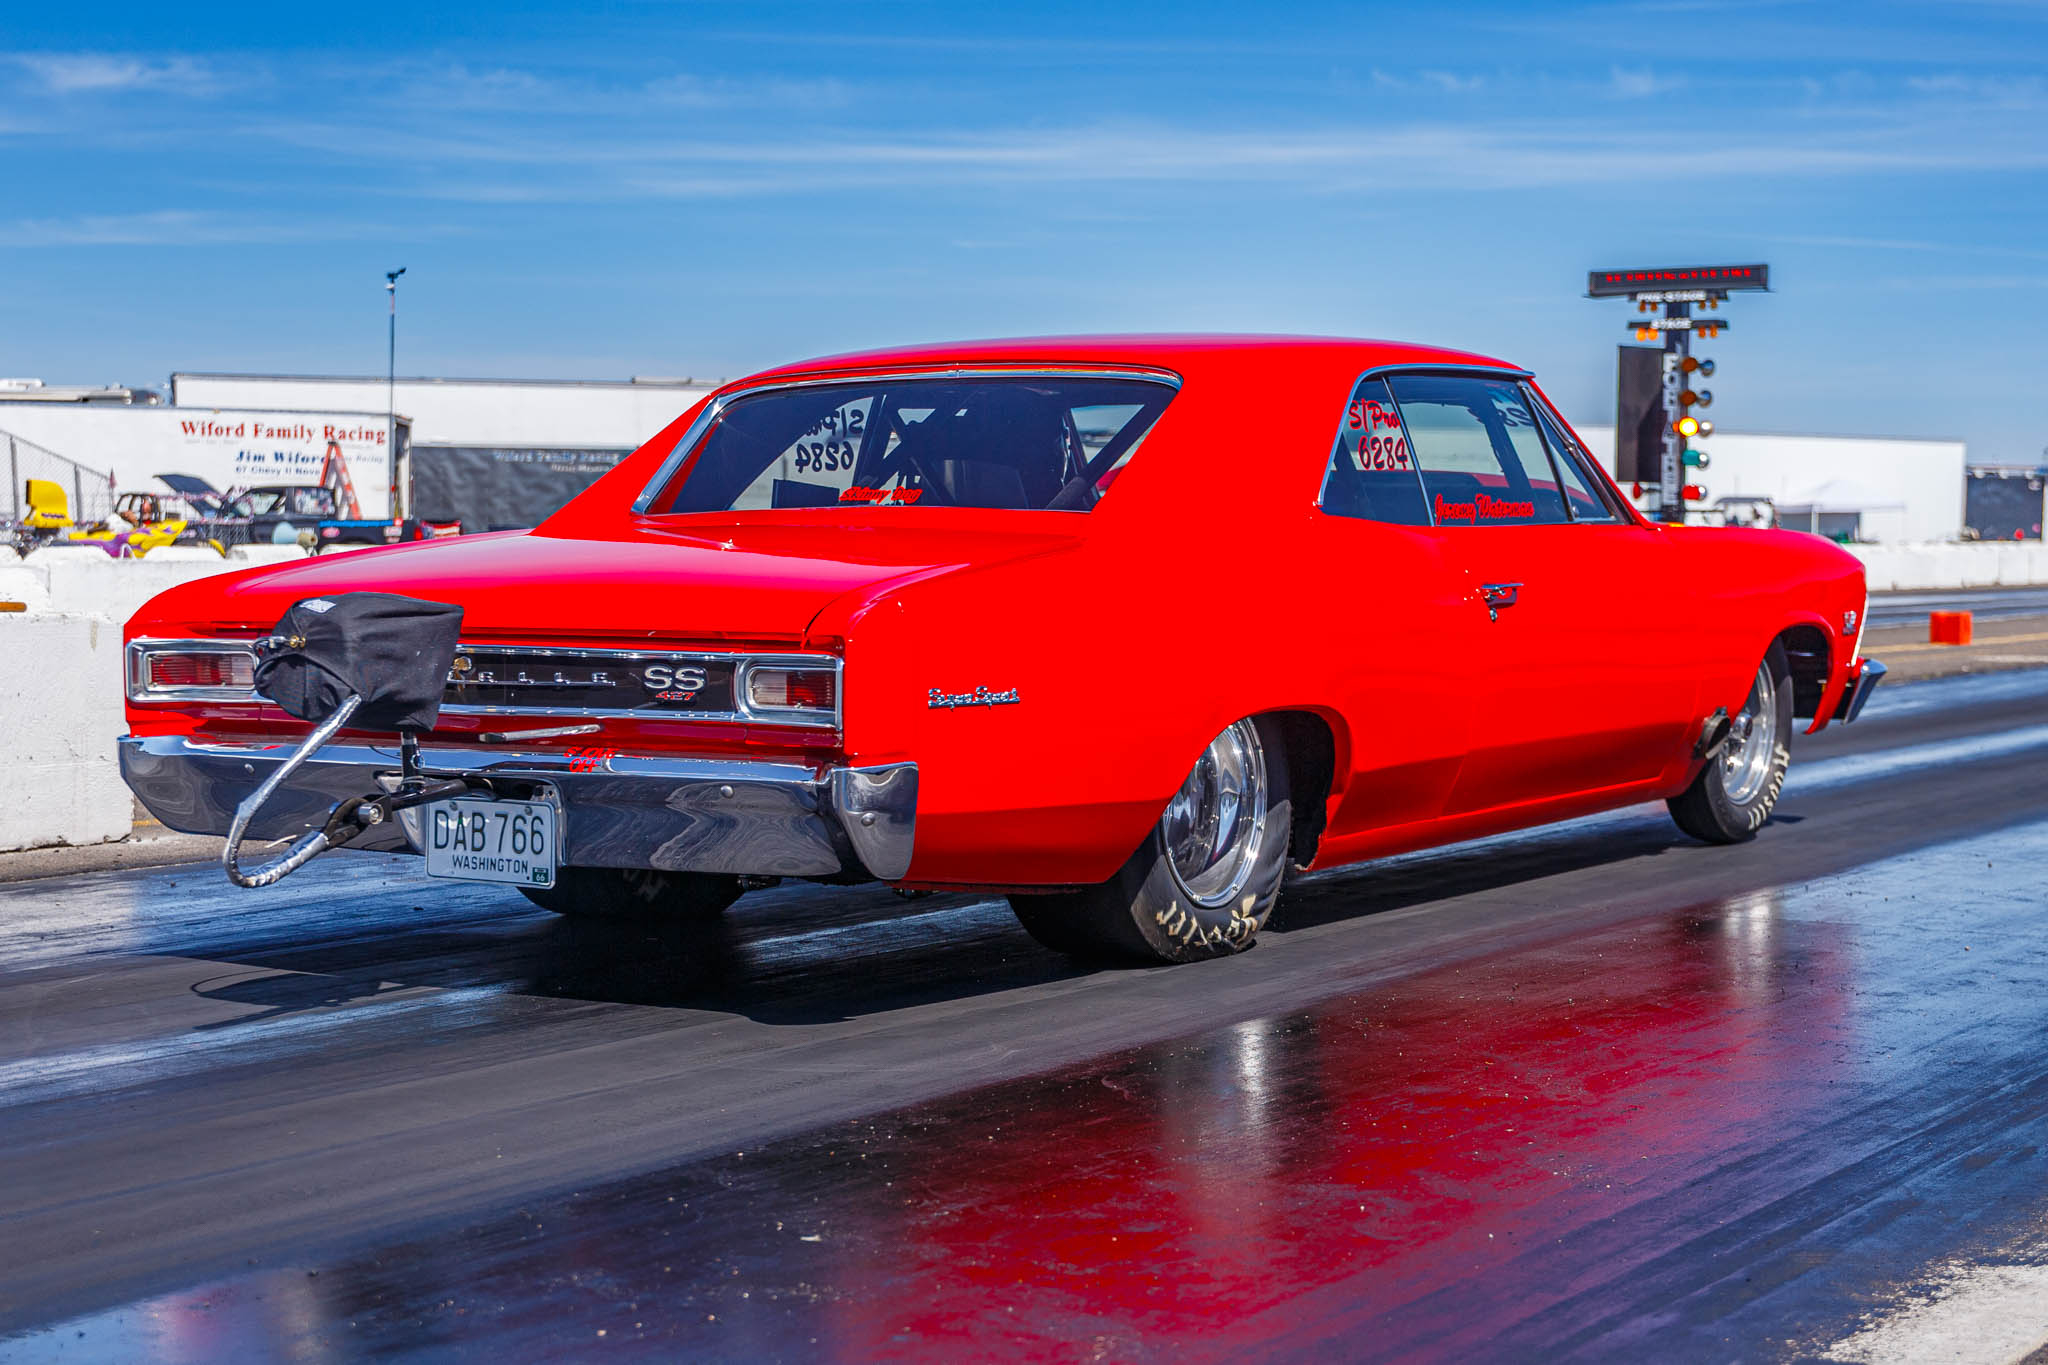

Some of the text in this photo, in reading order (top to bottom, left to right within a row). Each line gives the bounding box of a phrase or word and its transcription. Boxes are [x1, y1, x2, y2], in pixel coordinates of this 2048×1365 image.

[181, 421, 386, 445] Wiford Family Racing
[235, 451, 265, 463] Jim
[1358, 436, 1408, 471] 6284
[251, 466, 281, 476] Chevy
[839, 486, 923, 504] Skinny Dog
[644, 665, 704, 690] SS
[656, 691, 696, 701] 427
[434, 810, 544, 855] DAB 766
[452, 855, 529, 875] WASHINGTON
[535, 873, 546, 882] 66
